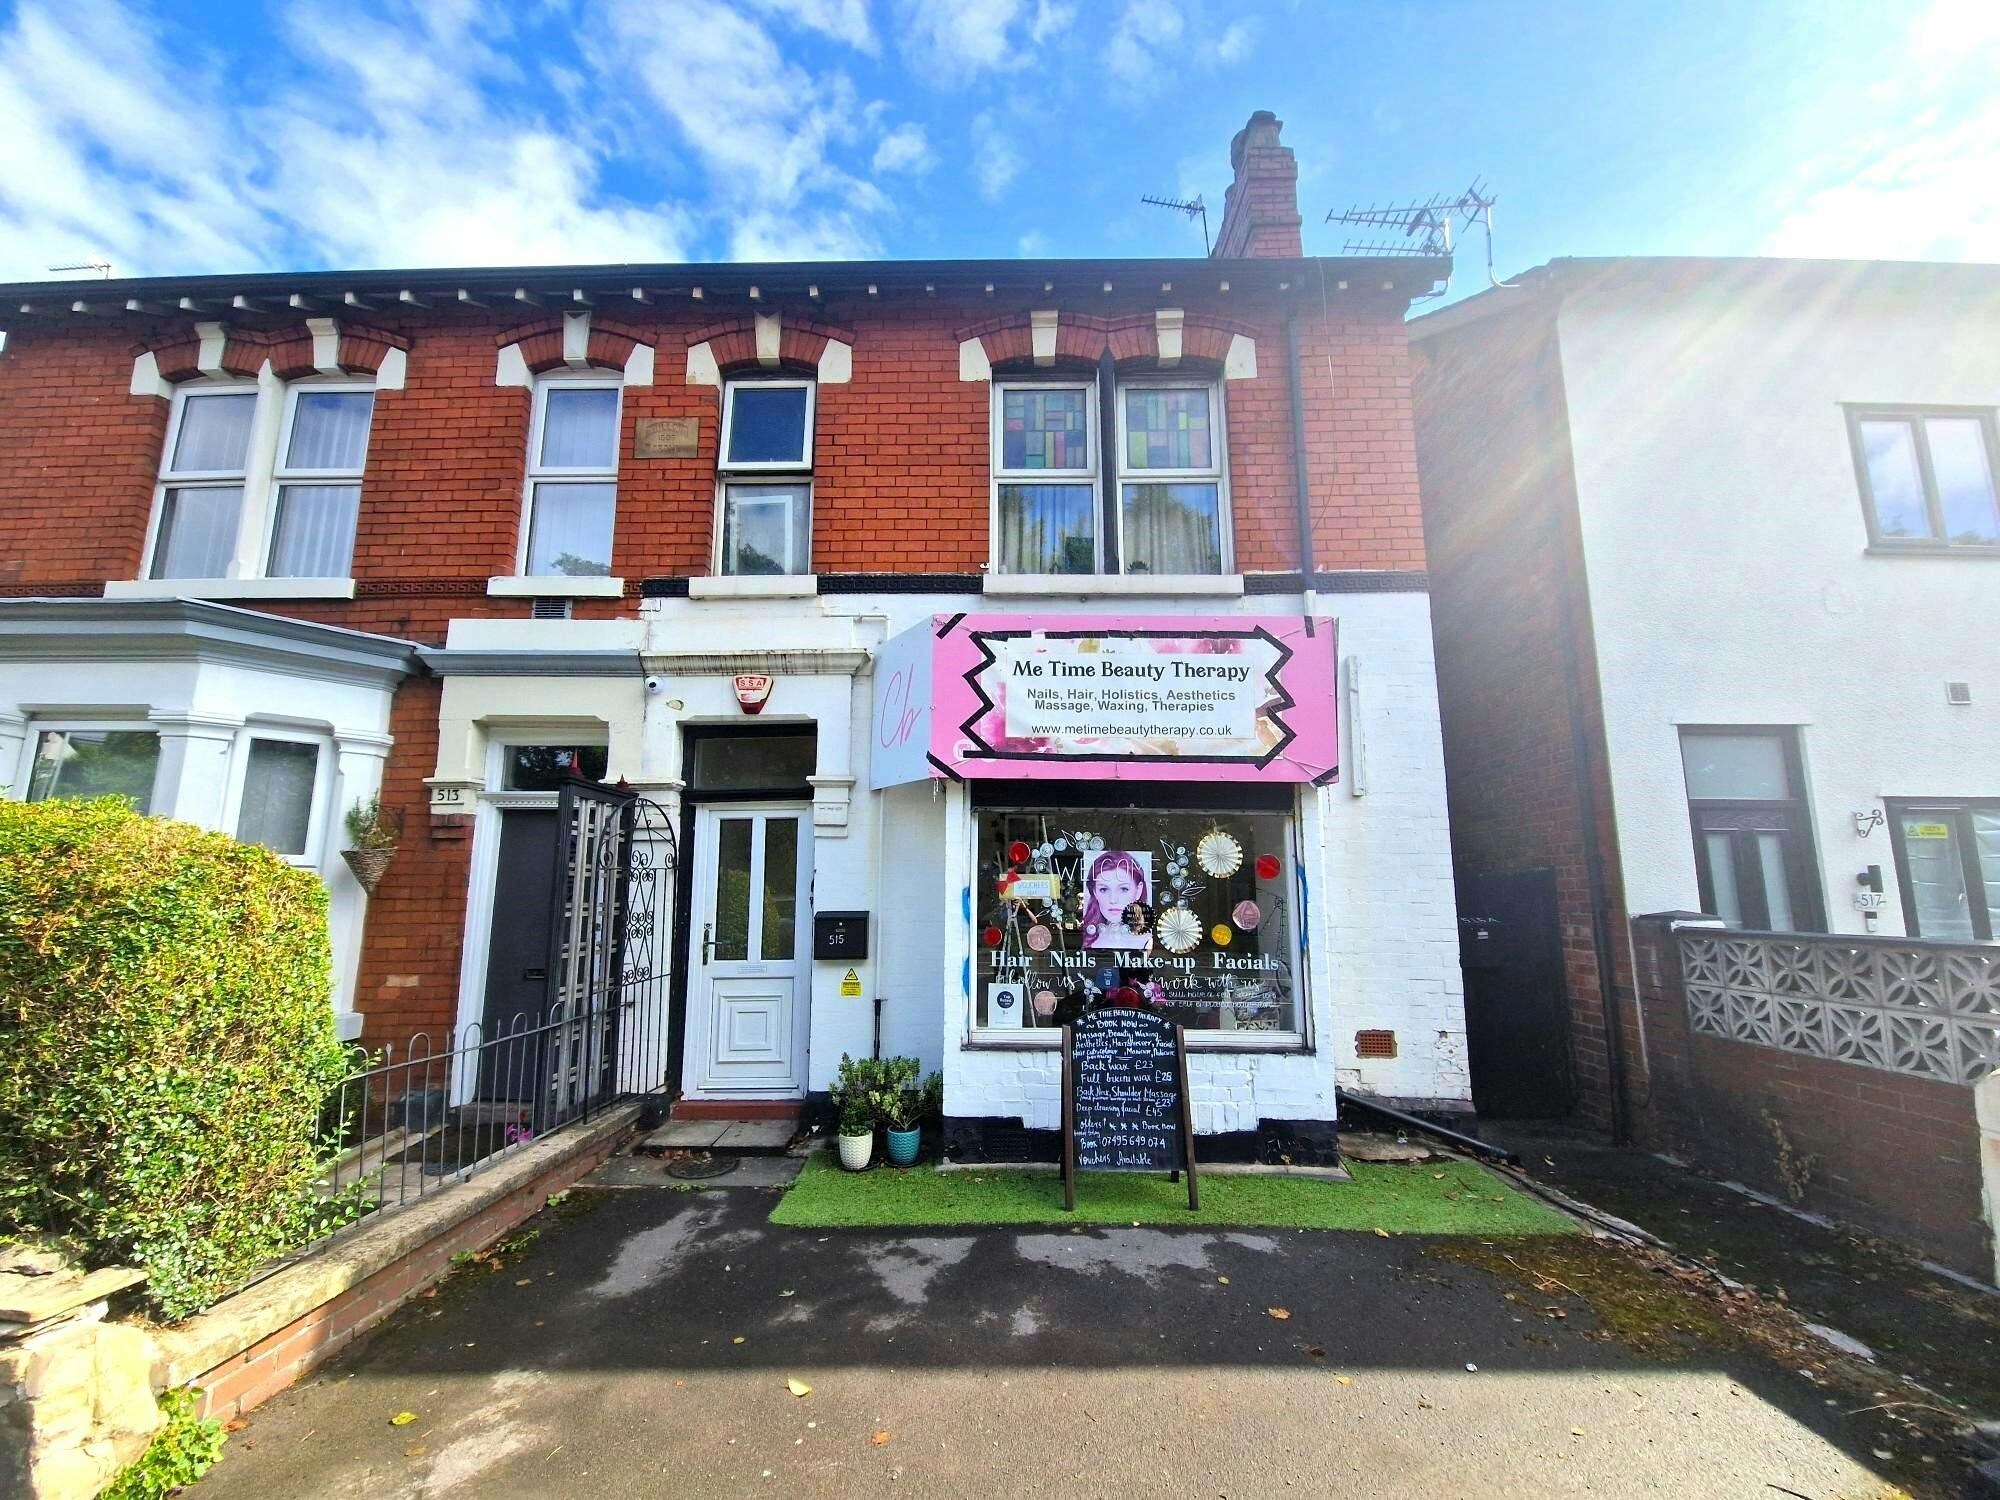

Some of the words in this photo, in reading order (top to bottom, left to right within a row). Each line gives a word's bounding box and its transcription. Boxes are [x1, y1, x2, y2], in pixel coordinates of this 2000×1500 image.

[1013, 660, 1043, 677] Me
[1048, 660, 1096, 677] Time
[1101, 661, 1165, 682] Beauty
[1171, 661, 1250, 682] Therapy
[1027, 688, 1063, 701] Nails,
[1067, 688, 1098, 702] Hair,
[1101, 689, 1162, 702] Holistics,
[1166, 689, 1236, 701] Aesthetics
[1034, 700, 1094, 713] Massage,
[1098, 700, 1148, 714] Waxing,
[1152, 701, 1215, 714] Therapies
[1031, 724, 1232, 738] www.metimebeautytherapy.co.uk
[437, 789, 460, 801] 513
[1860, 894, 1882, 906] 517
[829, 934, 845, 945] 515
[990, 950, 1033, 968] Hair
[1049, 950, 1097, 968] Nails
[1113, 951, 1196, 975] Make-up
[1212, 951, 1279, 970] Facials
[1087, 1013, 1098, 1021] ME
[1113, 1009, 1136, 1018] BEAUTY
[1096, 1020, 1118, 1029] BOOK
[1121, 1020, 1138, 1028] NOW
[1081, 1060, 1107, 1073] Back
[1108, 1063, 1130, 1072] wax
[1134, 1059, 1154, 1070] £23
[1080, 1072, 1100, 1084] Full
[1106, 1072, 1131, 1083] bikini
[1133, 1074, 1152, 1083] wax
[1111, 1085, 1142, 1097] Shoulder
[1143, 1086, 1177, 1103] Massage
[1076, 1102, 1093, 1118] Deep
[1145, 1105, 1163, 1117] £45
[1155, 1099, 1172, 1108] £23
[1129, 1135, 1146, 1147] 649
[1148, 1137, 1167, 1149] 074
